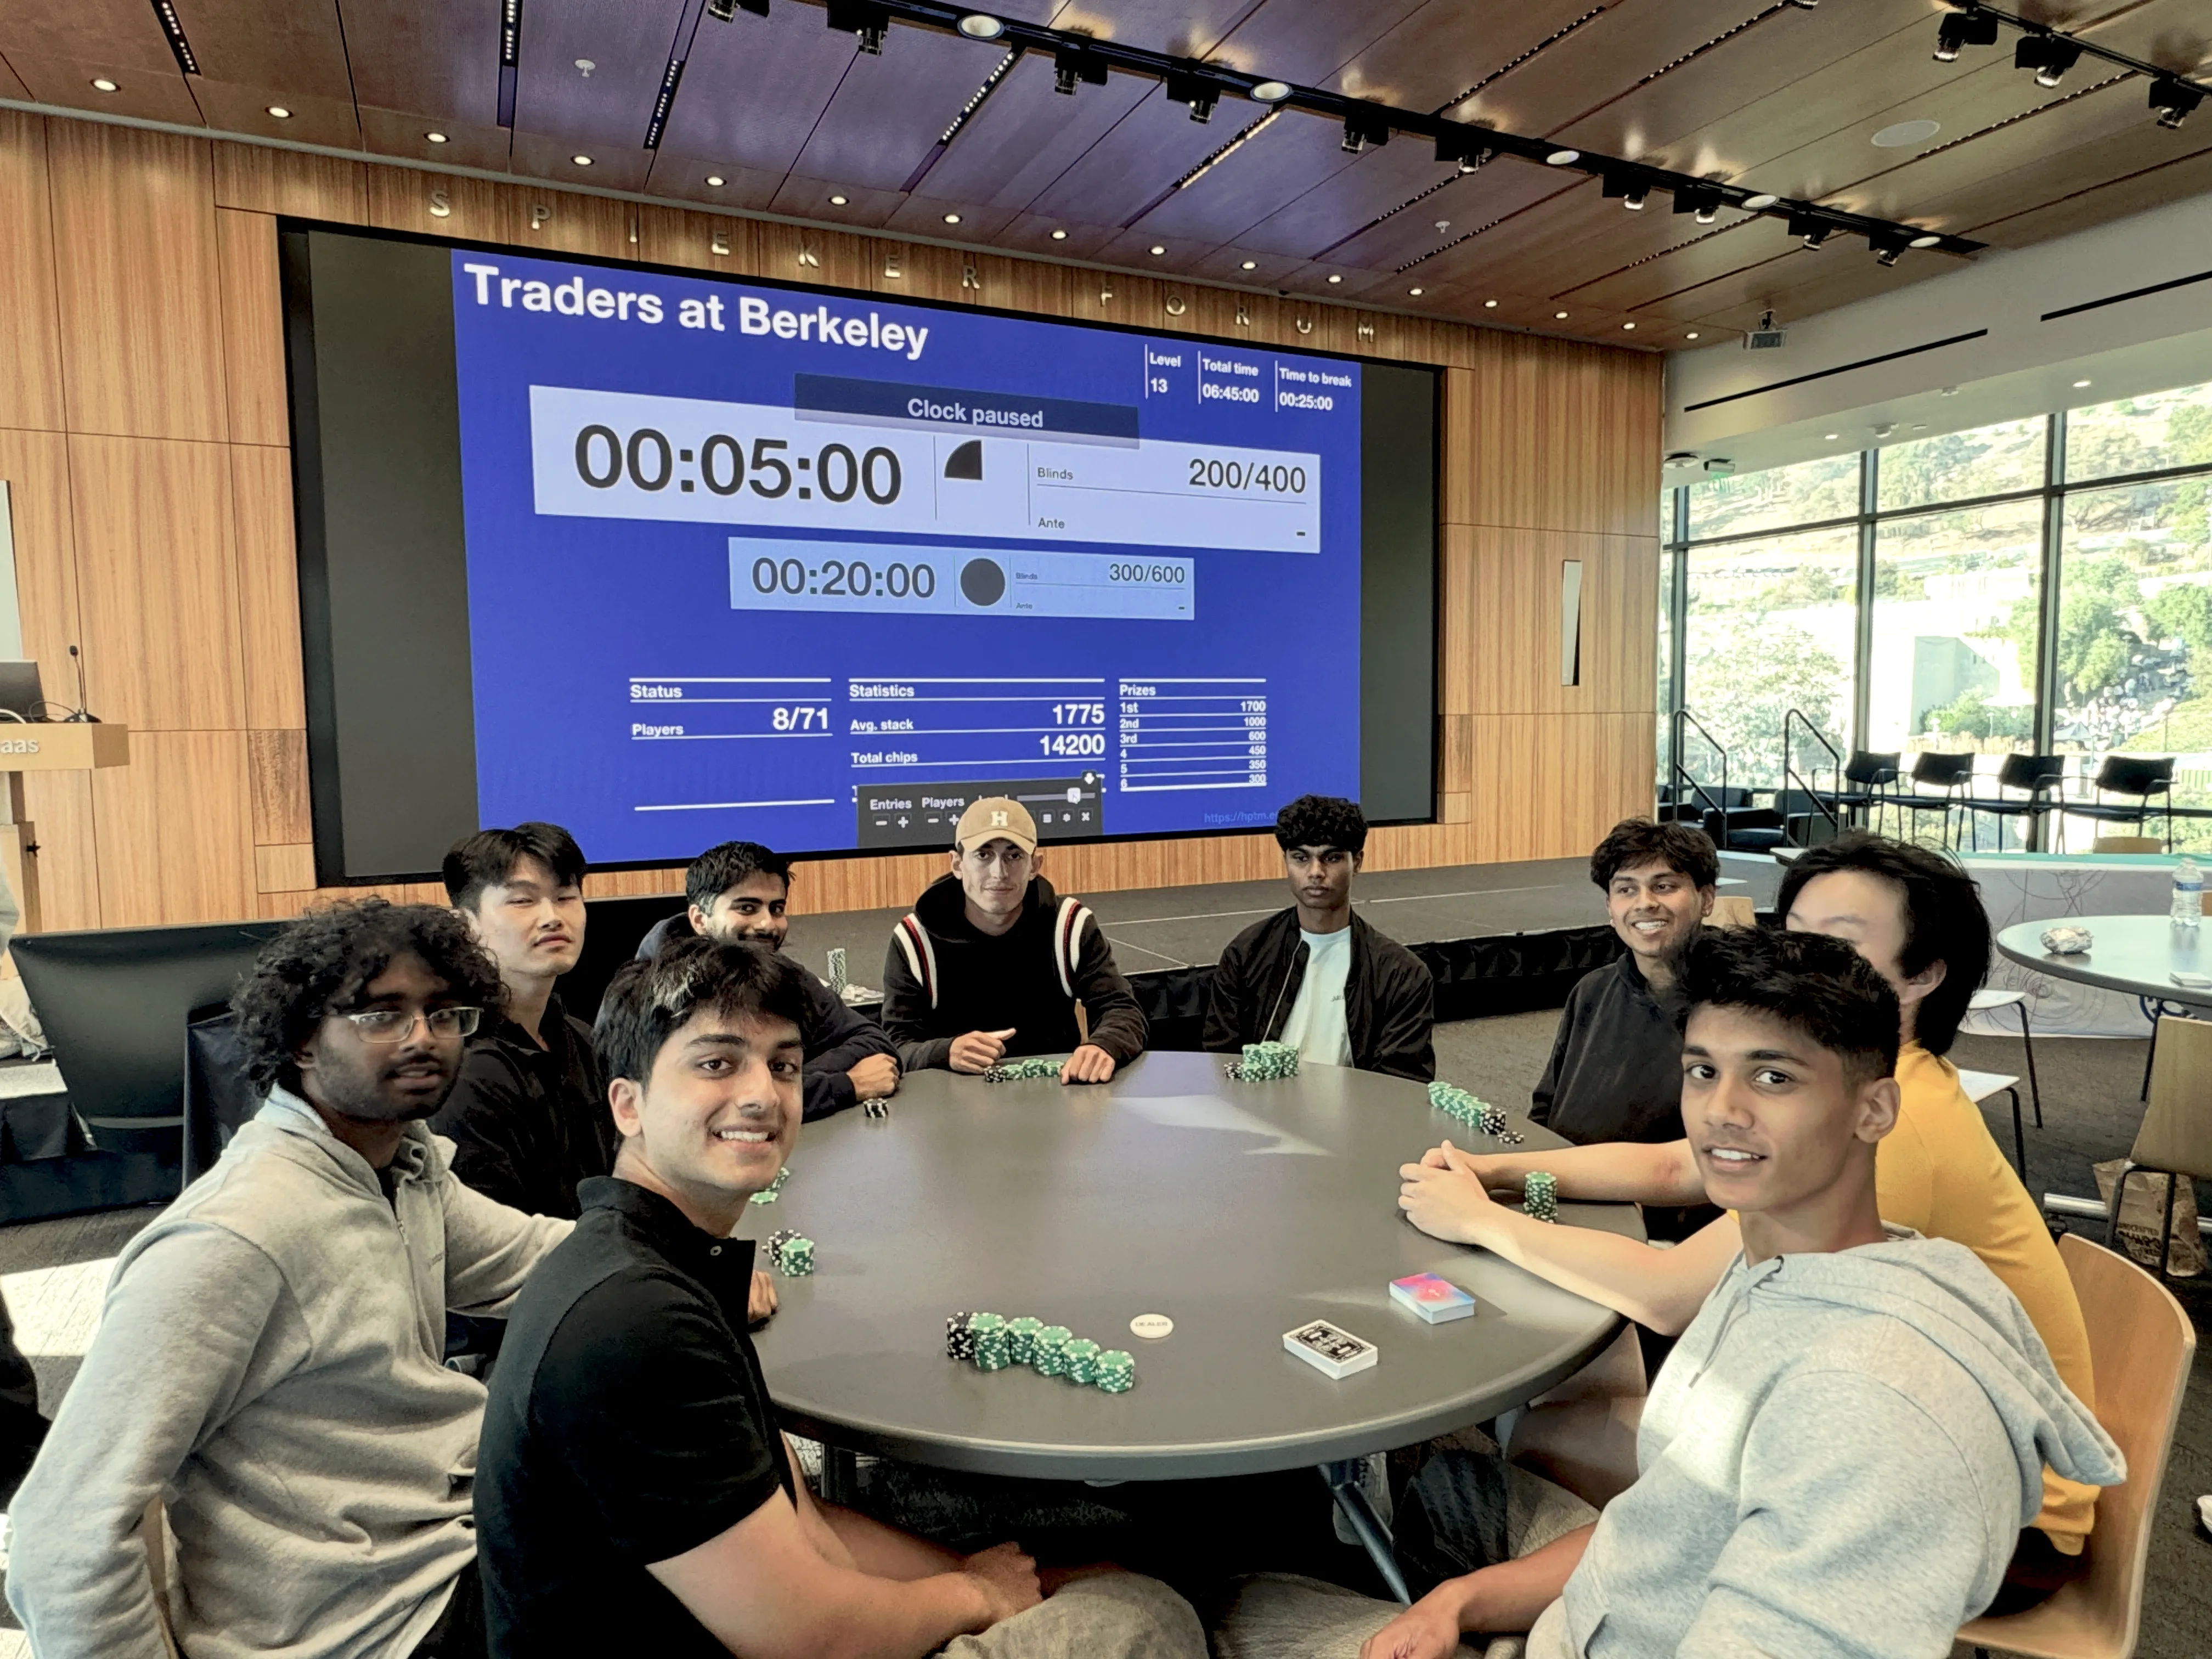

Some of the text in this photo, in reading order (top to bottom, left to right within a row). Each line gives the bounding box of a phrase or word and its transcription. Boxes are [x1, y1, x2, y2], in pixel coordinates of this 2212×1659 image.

[430, 189, 1374, 342] SPIEKER FORUM
[465, 263, 928, 360] Traders at Berkeley
[1150, 352, 1181, 367] Level
[1203, 358, 1259, 376] Total time
[1279, 368, 1351, 387] Time to break
[1150, 379, 1168, 393] 13
[1203, 383, 1260, 403] 06:45:00
[1279, 392, 1333, 411] 00:25:00
[908, 398, 1043, 428] Clock paused
[575, 424, 901, 505] 00:05:00
[1037, 467, 1074, 480] Blinds
[1189, 459, 1306, 493] 200/400
[1038, 517, 1065, 529] Ante
[752, 557, 935, 597] 00:20:00
[1109, 563, 1185, 583] 300/600
[630, 684, 683, 698] Status
[849, 684, 915, 697] Statistics
[1119, 684, 1156, 696] Prizes
[1120, 702, 1138, 713] 1st
[1240, 701, 1266, 712] 1700
[772, 707, 828, 730] 8/71
[1053, 704, 1105, 725] 1775
[1244, 716, 1266, 726] 1000
[631, 723, 684, 737] Players
[850, 718, 913, 731] Avg. stack
[1120, 718, 1139, 729] 2nd
[1120, 733, 1138, 744] 3rd
[1249, 731, 1266, 741] 600
[1040, 734, 1105, 755] 14200
[1249, 745, 1266, 755] 450
[851, 751, 918, 764] Total chips
[1120, 748, 1127, 759] 4
[1120, 763, 1128, 774] 5
[1249, 759, 1266, 769] 350
[1120, 778, 1128, 788] 6
[1249, 774, 1266, 783] 300
[870, 798, 912, 810] Entries
[922, 796, 964, 809] Players
[991, 811, 1008, 826] H
